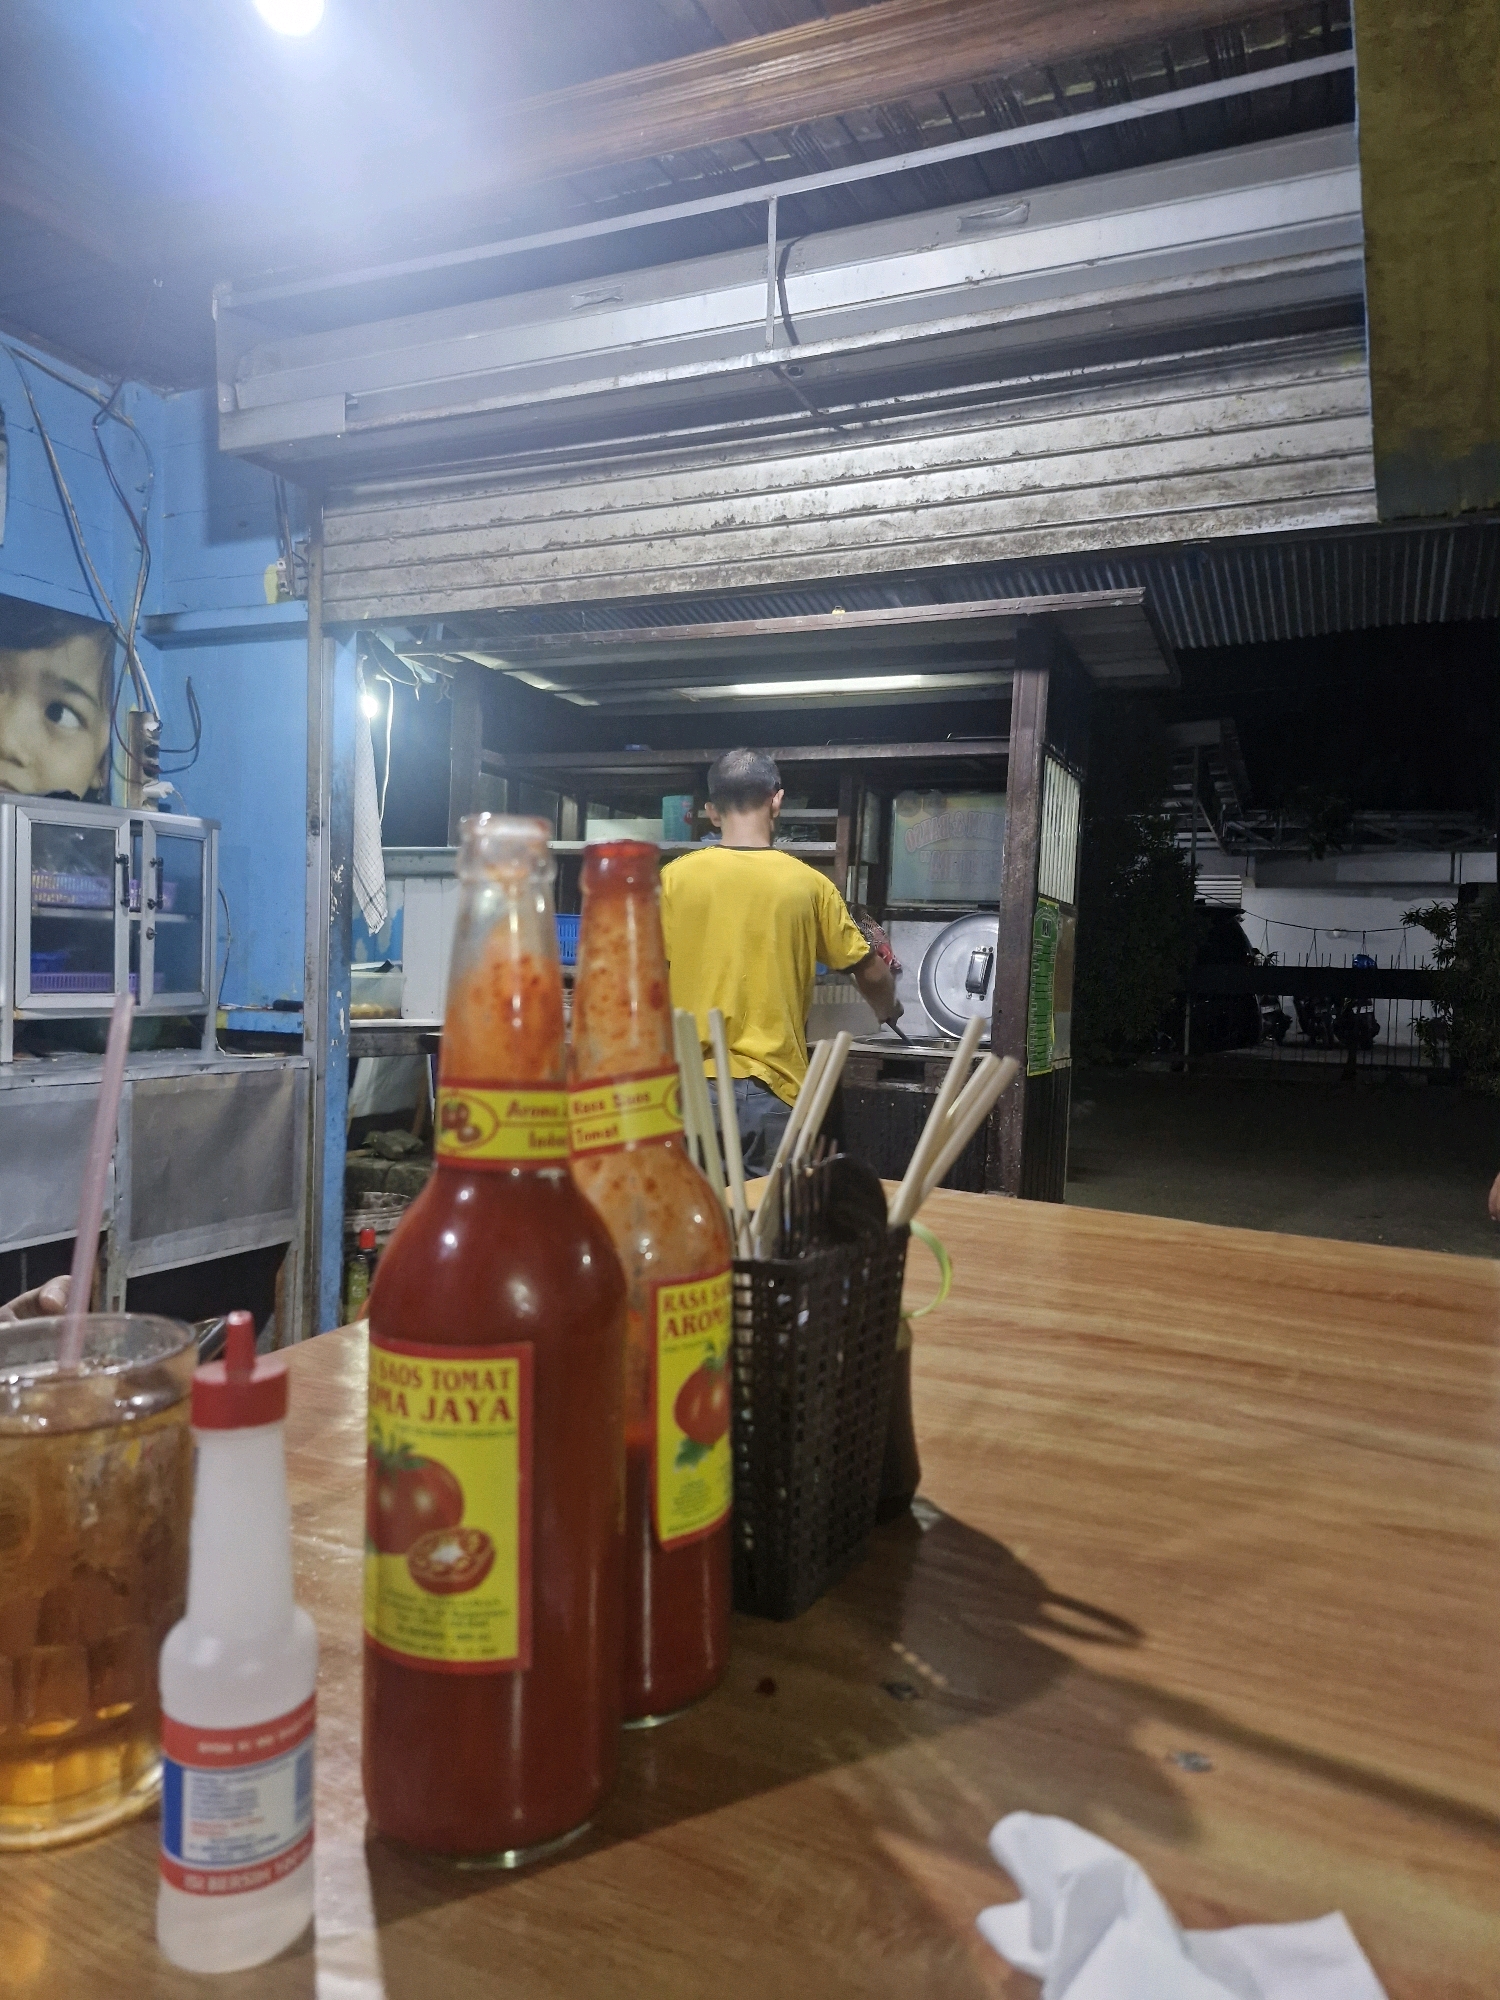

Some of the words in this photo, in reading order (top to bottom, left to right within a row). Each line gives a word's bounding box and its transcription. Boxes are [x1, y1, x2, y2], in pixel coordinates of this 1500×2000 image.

[662, 1306, 727, 1339] AROM
[430, 1367, 513, 1391] TOMAT
[420, 1395, 512, 1424] JAYA
